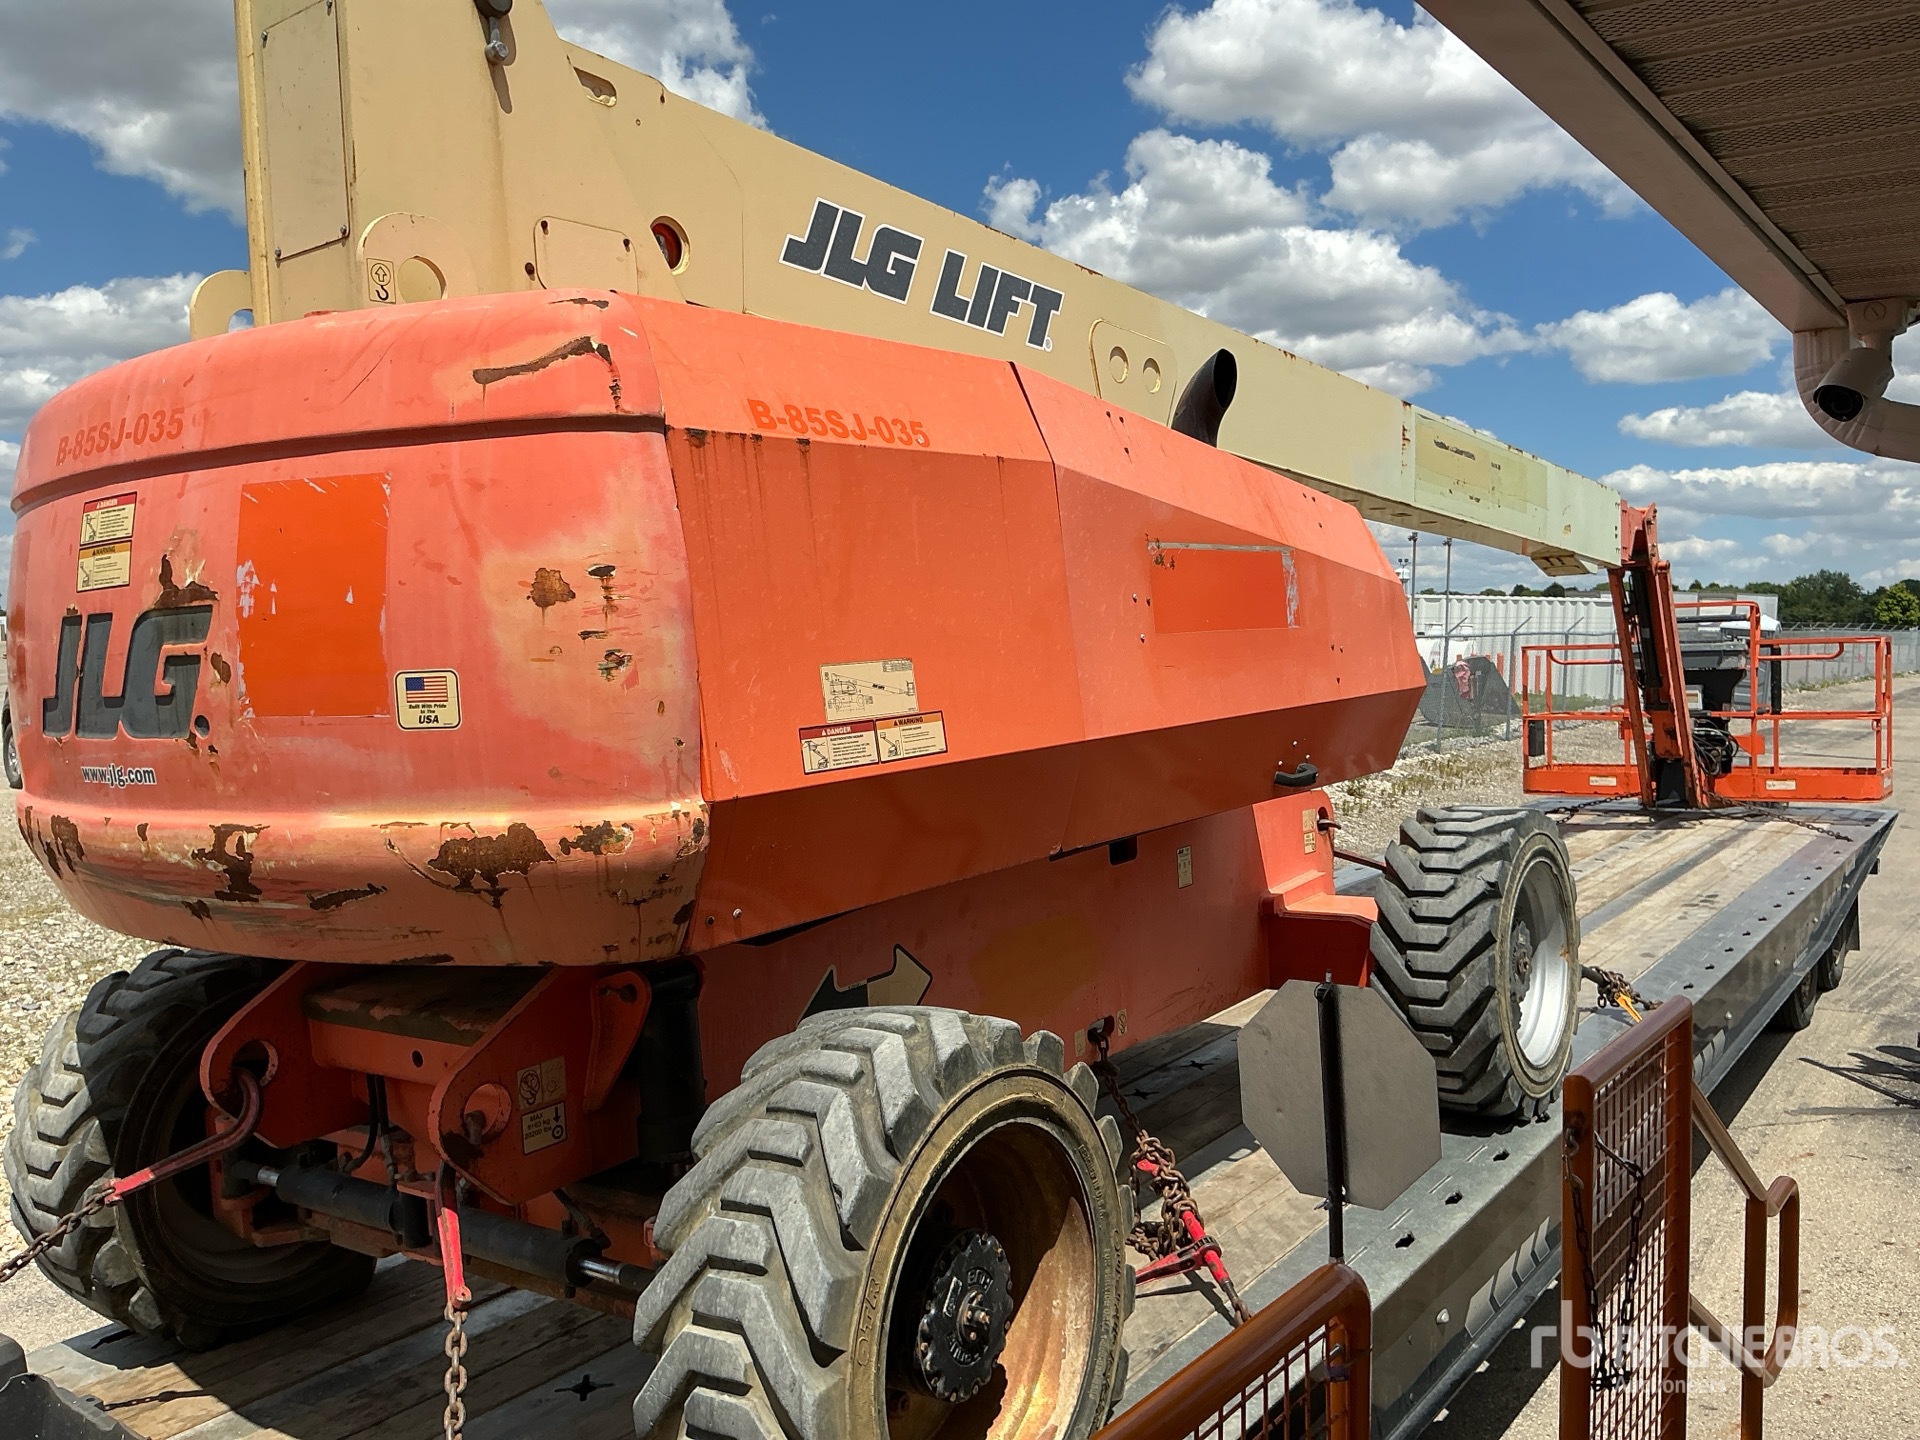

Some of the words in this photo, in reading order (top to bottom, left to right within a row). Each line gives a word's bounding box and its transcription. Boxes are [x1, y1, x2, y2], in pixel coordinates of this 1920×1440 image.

[779, 197, 925, 305] JLG
[747, 398, 931, 449] B-85SJ-035
[56, 407, 185, 466] B-85SJ-035
[418, 714, 440, 724] USA
[897, 716, 924, 726] WARNING
[826, 726, 852, 736] DANGER
[81, 763, 157, 789] www.jlg.com
[530, 1112, 544, 1122] MAX
